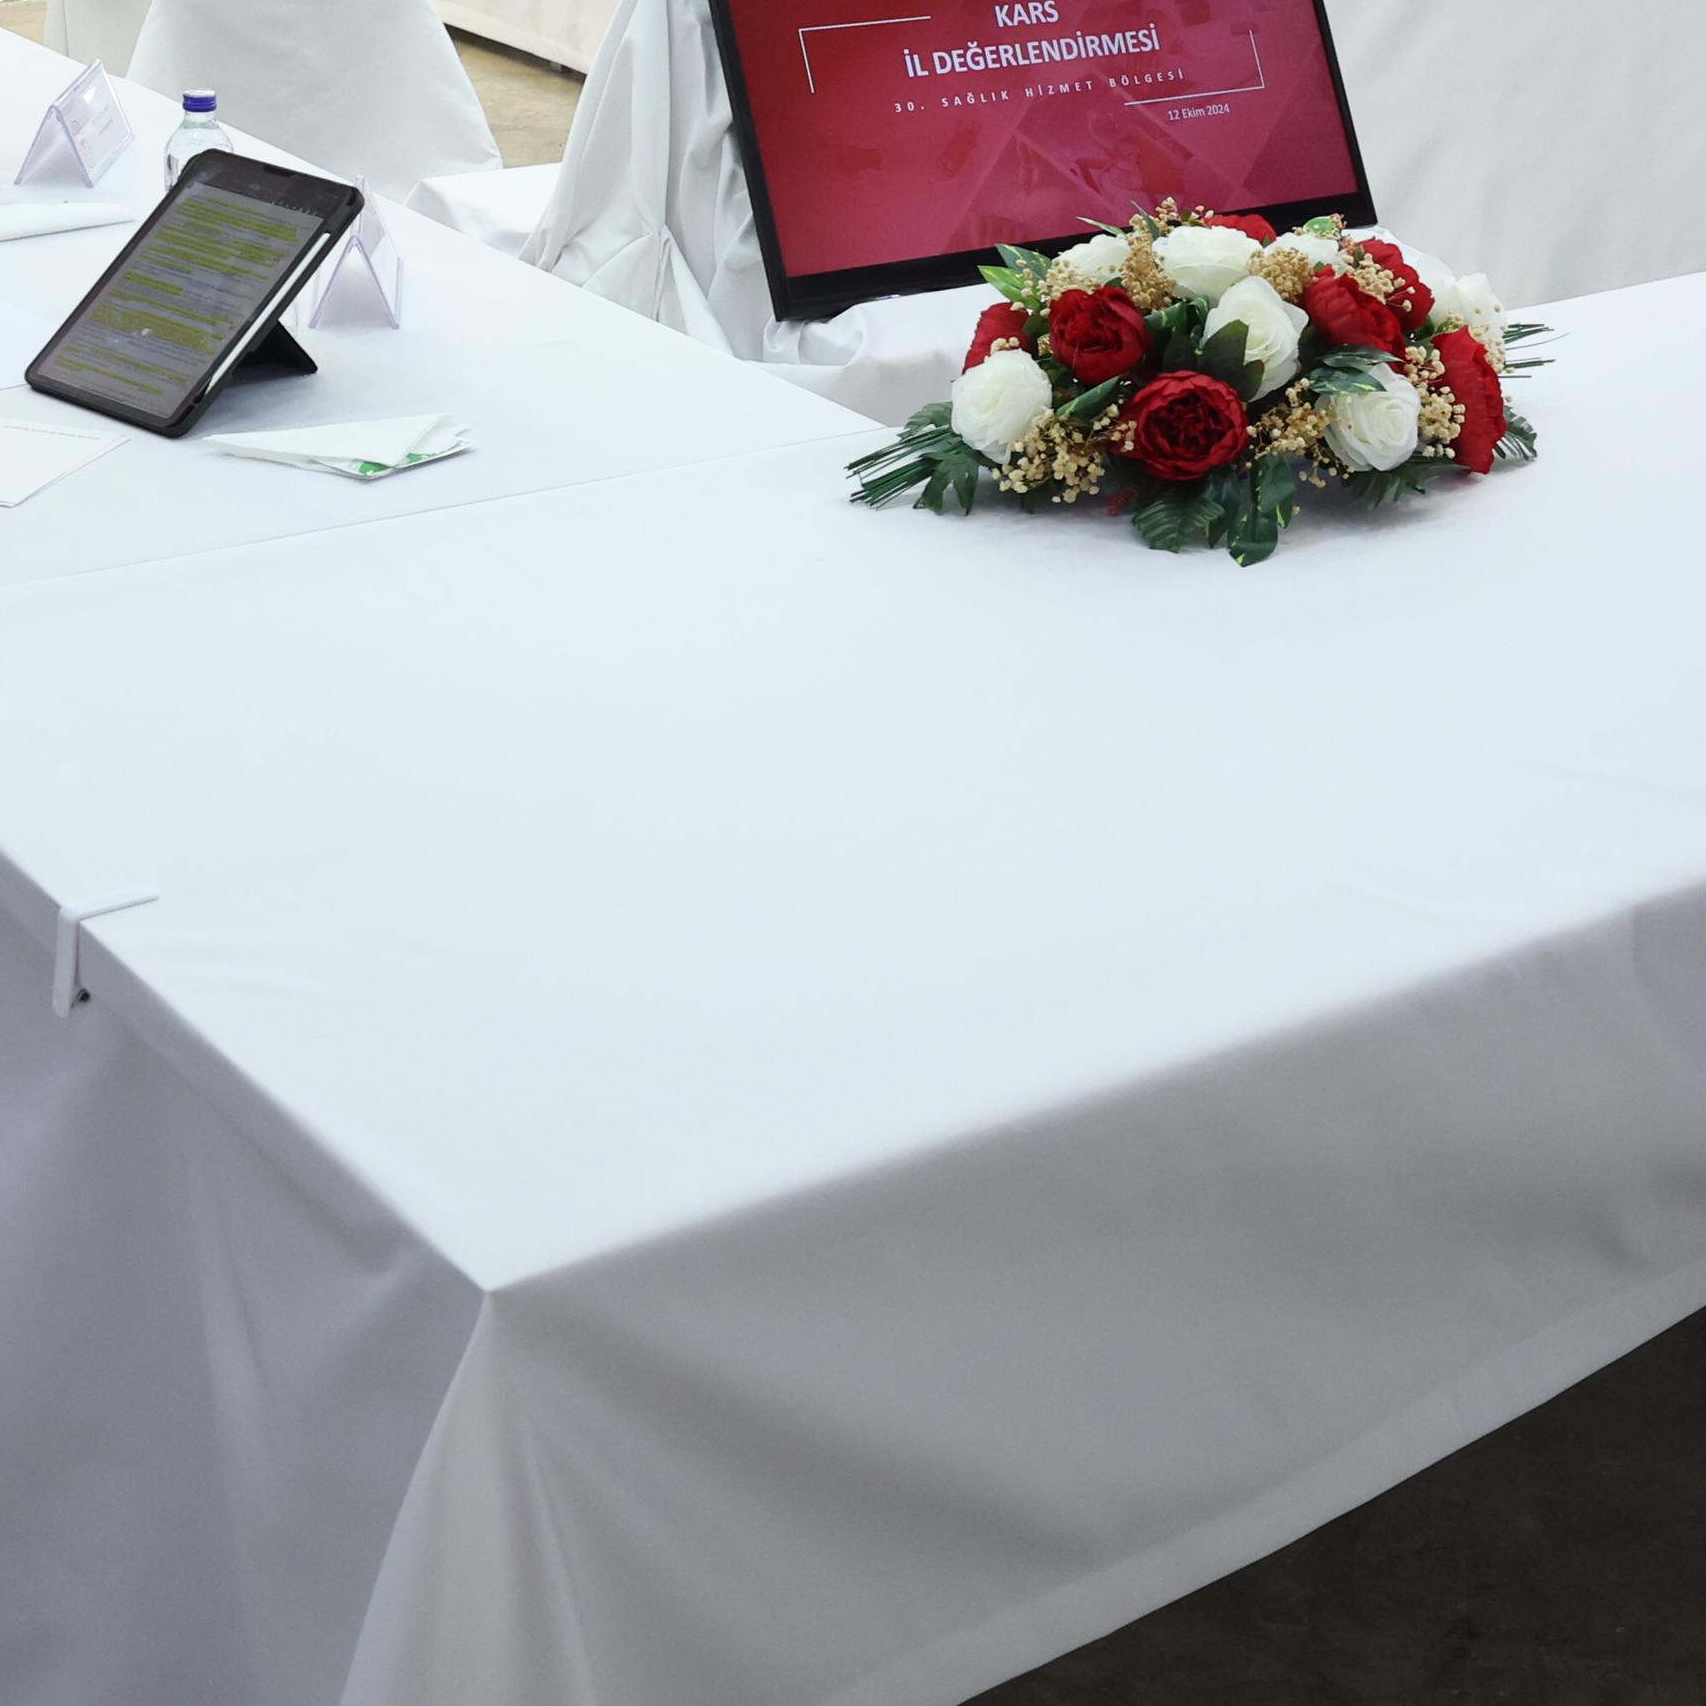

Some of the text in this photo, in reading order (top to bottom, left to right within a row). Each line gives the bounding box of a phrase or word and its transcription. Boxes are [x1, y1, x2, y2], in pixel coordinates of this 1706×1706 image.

[994, 0, 1060, 28] KARS
[903, 22, 1161, 77] İL DEĞERLENDİRMESİ
[894, 67, 1185, 113] 30. SAĞLIK HİZMET BÖLGESİ
[1168, 103, 1230, 121] 12 Ekim 2024
